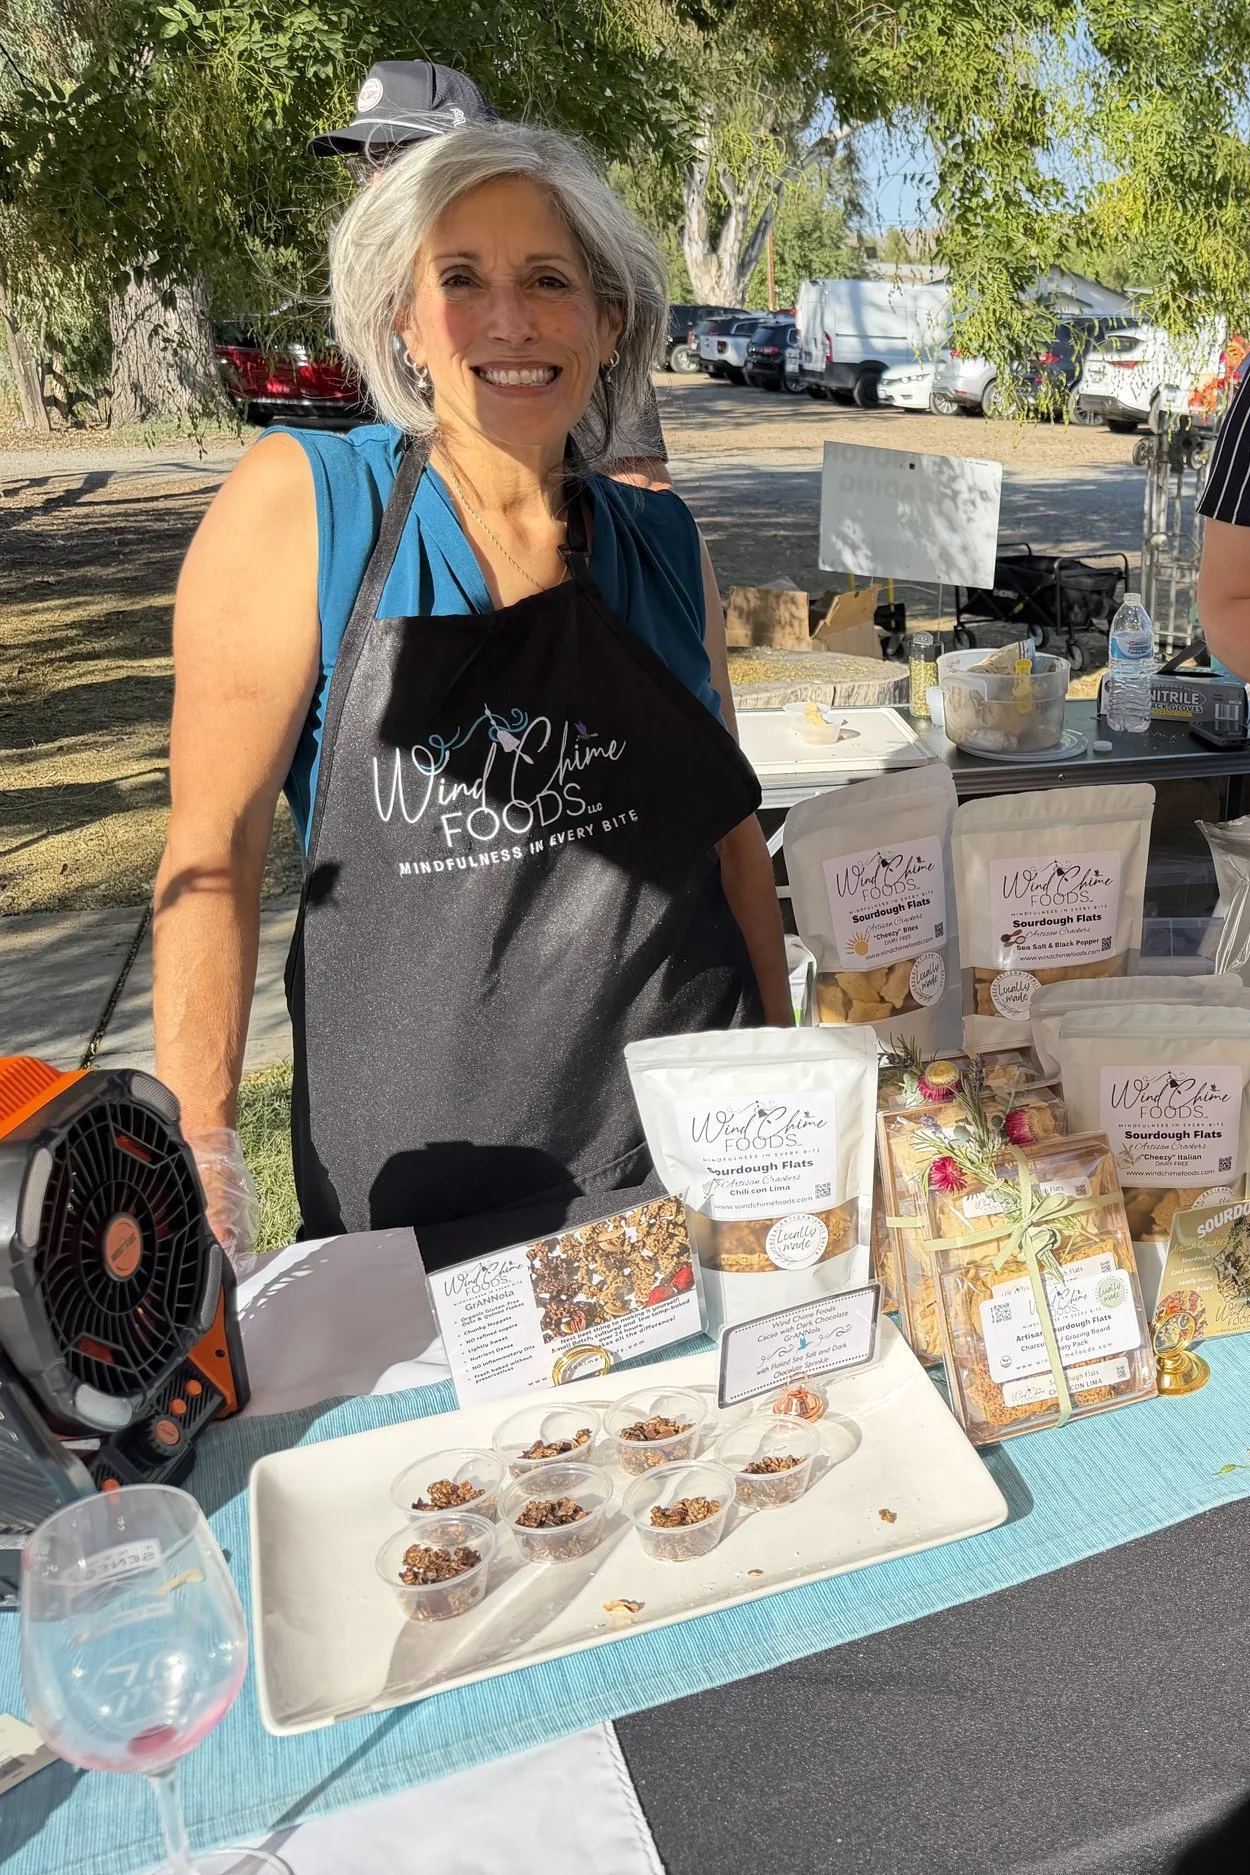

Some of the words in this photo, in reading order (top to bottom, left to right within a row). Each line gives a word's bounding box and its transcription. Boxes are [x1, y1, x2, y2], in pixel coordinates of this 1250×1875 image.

[1151, 689, 1199, 705] NITRILE
[1170, 704, 1203, 713] GLOVES
[373, 742, 497, 823] Wind
[511, 716, 626, 807] Chime
[441, 783, 587, 847] FOODS
[398, 846, 523, 877] MINDFULNESS
[530, 839, 544, 855] IN
[550, 823, 595, 846] EVERY
[602, 808, 640, 832] BITE
[836, 864, 880, 898] Wind
[884, 854, 935, 888] Chime
[1003, 869, 1056, 899] Wind
[1057, 865, 1113, 897] Chime
[861, 878, 917, 902] FOODS
[1030, 890, 1090, 907] FOODS
[852, 904, 905, 924] Sourdough
[907, 898, 931, 911] Flats
[1013, 915, 1074, 929] Sourdough
[1076, 913, 1102, 923] Flats
[1032, 942, 1047, 950] Salt
[1055, 940, 1074, 948] Black
[1075, 938, 1099, 947] Pepper
[1111, 1079, 1168, 1109] Wind
[1169, 1078, 1232, 1110] Chime
[1140, 1105, 1204, 1119] FOODS
[691, 1110, 756, 1143] Wind
[758, 1106, 827, 1139] Chime
[725, 1133, 797, 1152] FOODS
[1124, 1130, 1191, 1141] Sourdough
[1193, 1130, 1222, 1139] Flats
[782, 1159, 814, 1169] Flats
[1140, 1153, 1176, 1161] "Cheezy"
[729, 1188, 749, 1197] Chili
[769, 1184, 791, 1192] Lima
[714, 1196, 813, 1210] www.windchimefoods.com
[777, 1226, 817, 1243] Locally
[445, 1270, 481, 1296] Wind
[483, 1261, 523, 1284] Chime
[465, 1275, 508, 1296] FOODS
[465, 1290, 514, 1311] GrANNola
[595, 1325, 622, 1339] cultured
[623, 1320, 635, 1328] and
[638, 1314, 650, 1322] low
[757, 1332, 778, 1343] Cacao
[780, 1327, 795, 1336] with
[796, 1321, 813, 1332] Dark
[815, 1310, 849, 1326] Chocolate
[771, 1318, 791, 1328] Wind
[792, 1312, 814, 1322] Chime
[815, 1305, 836, 1316] Foods
[1092, 1313, 1112, 1324] Flats
[560, 1336, 576, 1345] Next
[577, 1329, 592, 1338] best
[593, 1322, 611, 1333] thing
[620, 1310, 645, 1322] making
[784, 1327, 821, 1342] GrANNola
[1065, 1330, 1090, 1341] Grazing
[1091, 1325, 1111, 1335] Board
[1072, 1339, 1089, 1348] Pack
[756, 1366, 770, 1376] with
[771, 1357, 791, 1371] Flaked
[792, 1355, 803, 1364] Sea
[805, 1350, 817, 1360] Salt
[818, 1347, 831, 1357] and
[832, 1342, 847, 1352] Dark
[773, 1365, 803, 1379] Chocolate
[804, 1357, 829, 1370] Sprinkle
[1070, 1382, 1086, 1391] CON
[1086, 1378, 1103, 1387] LIMA
